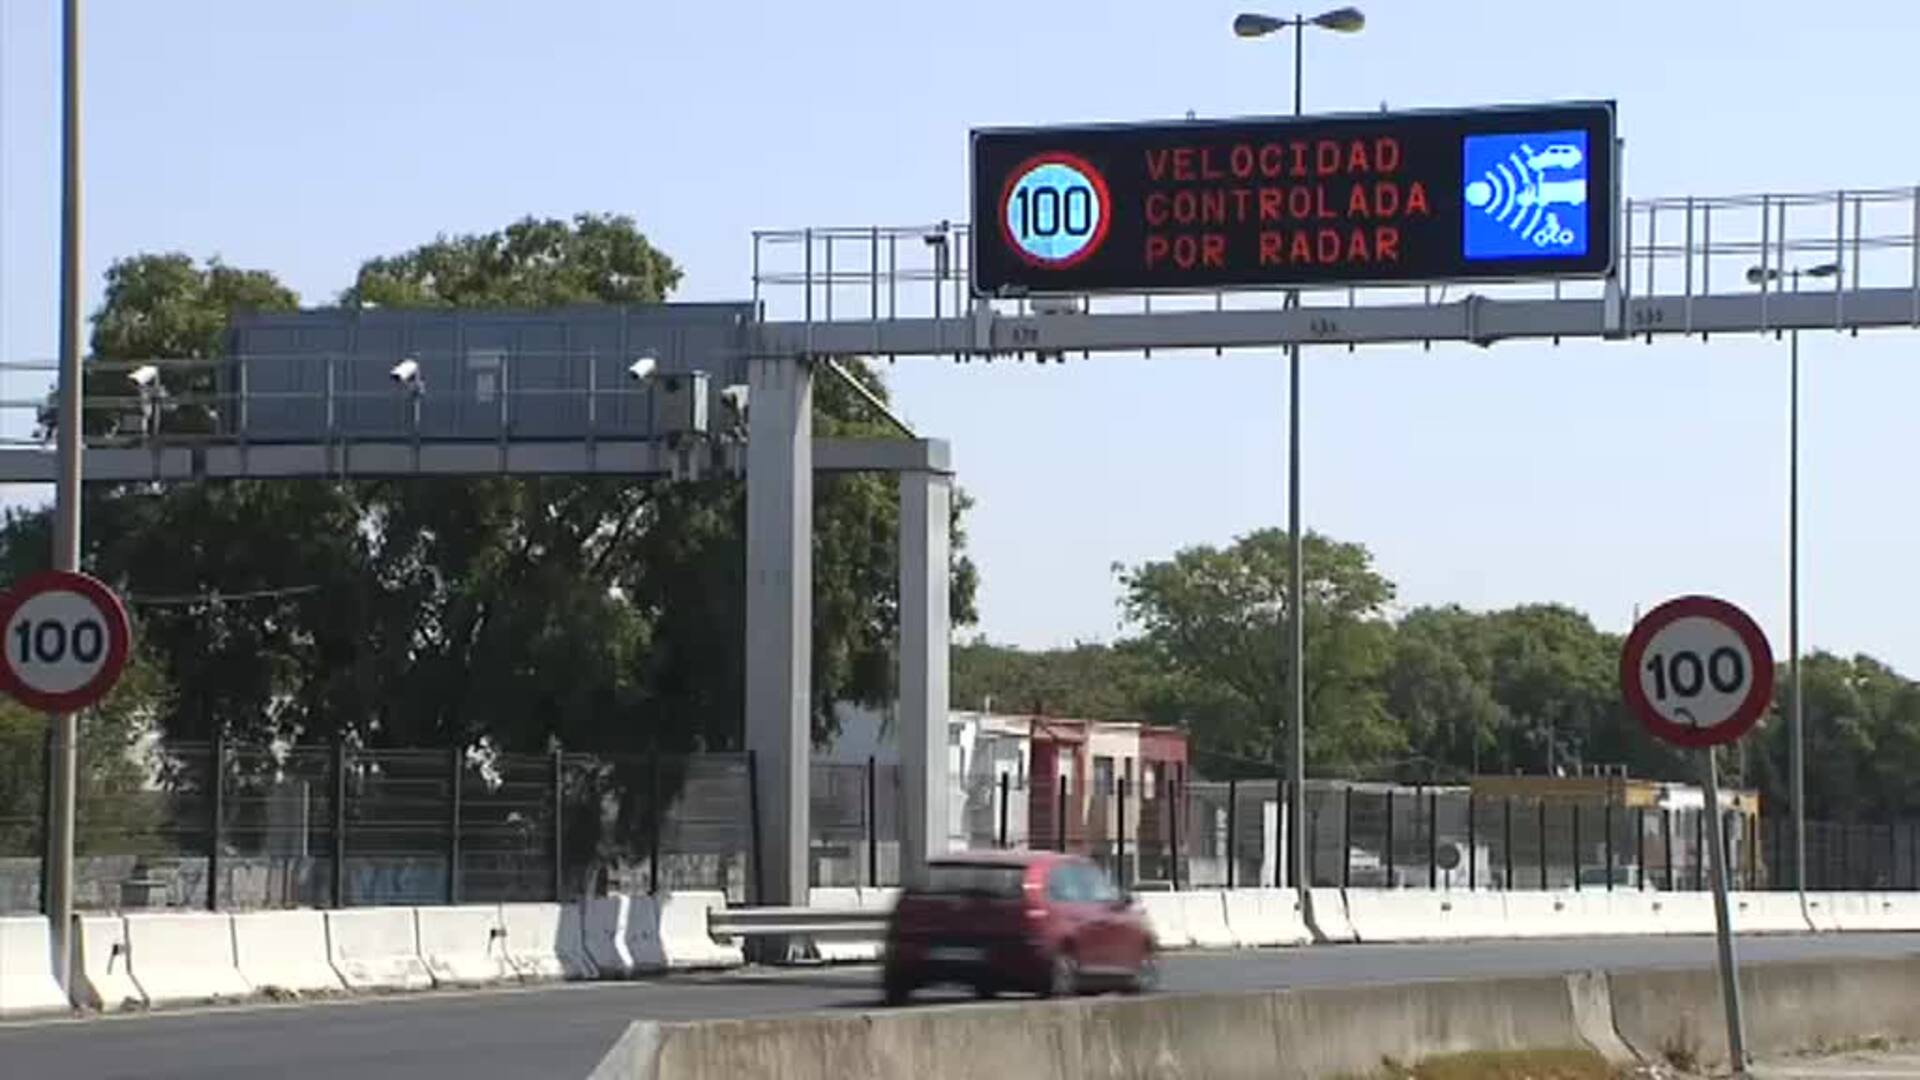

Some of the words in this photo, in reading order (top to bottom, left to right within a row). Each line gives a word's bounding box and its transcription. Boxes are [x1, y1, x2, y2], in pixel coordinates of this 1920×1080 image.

[1144, 137, 1400, 180] VELOCIDAD
[1016, 185, 1092, 240] 100
[1145, 182, 1430, 225] CONTROLADA
[1145, 234, 1225, 270] POR
[1259, 226, 1400, 267] RADAR
[15, 619, 103, 663] 100
[1646, 646, 1744, 701] 100
